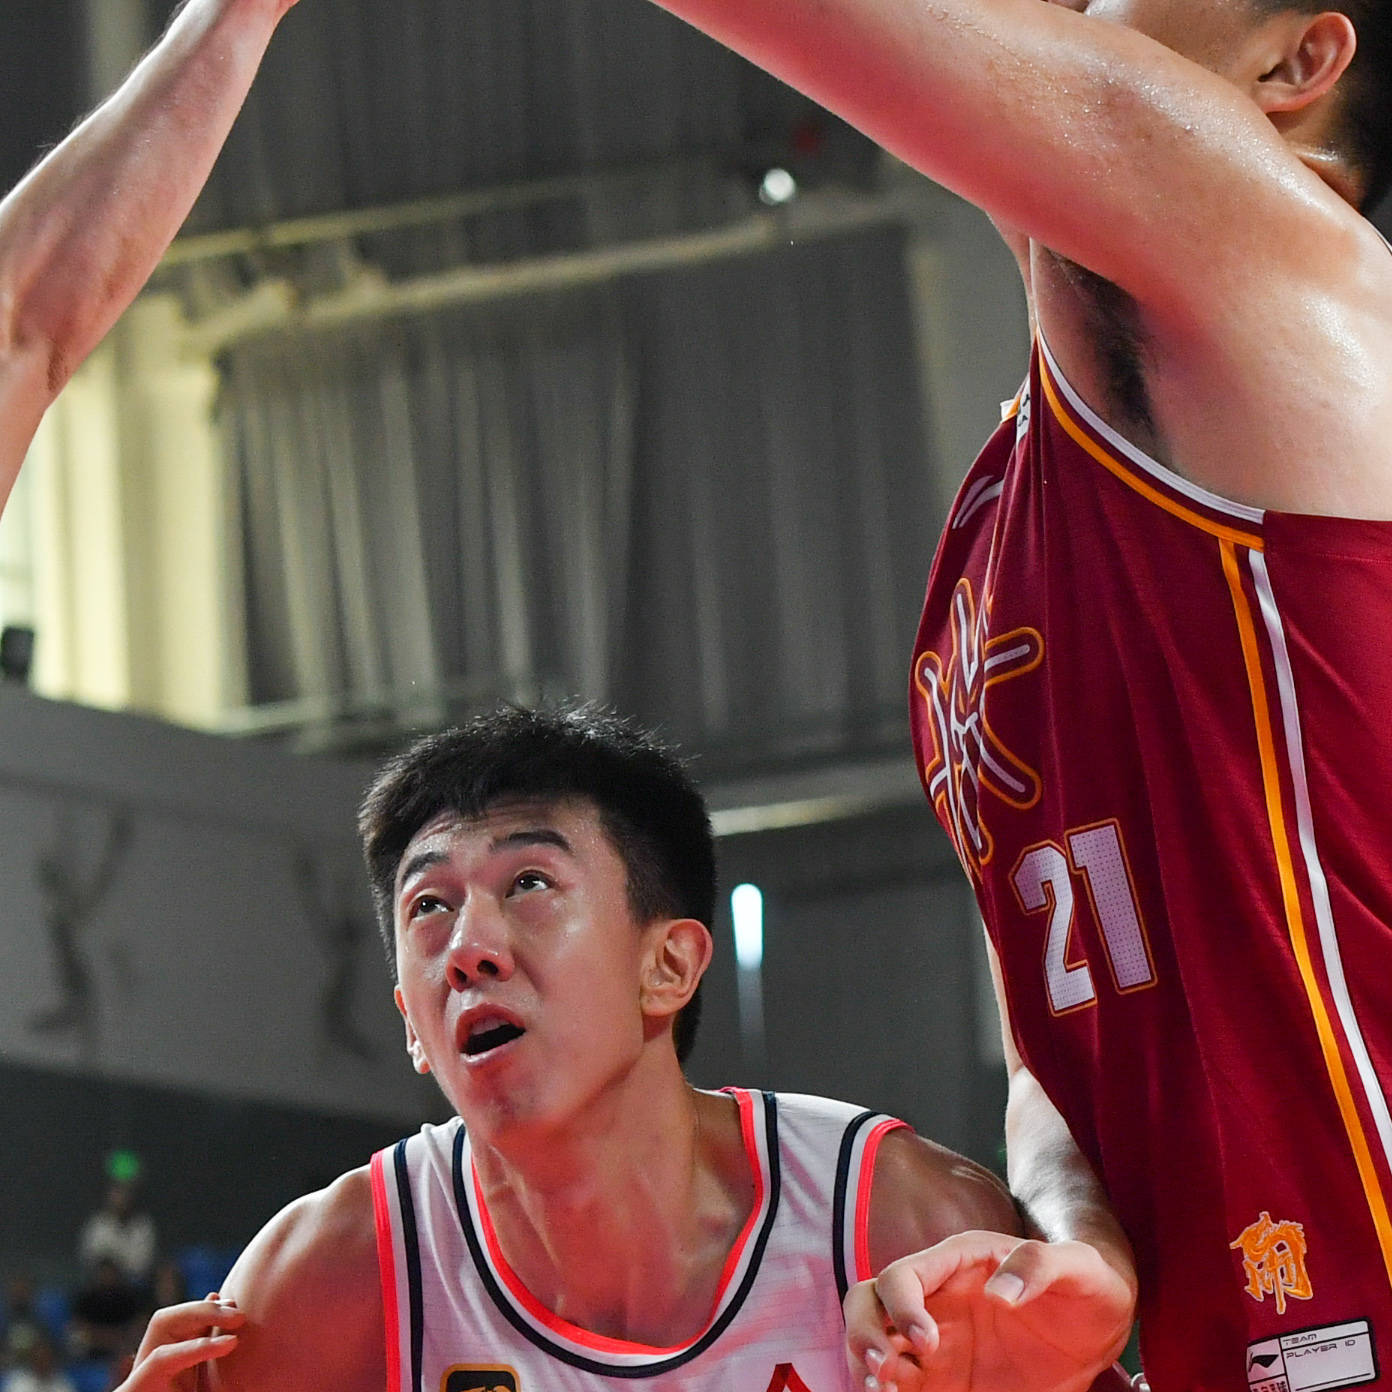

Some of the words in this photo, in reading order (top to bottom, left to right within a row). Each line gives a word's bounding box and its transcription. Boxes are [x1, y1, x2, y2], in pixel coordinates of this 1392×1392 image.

[1010, 818, 1157, 1017] 21
[1283, 1333, 1317, 1346] TEAM
[1286, 1343, 1338, 1359] PLAYER
[1344, 1339, 1356, 1347] ID
